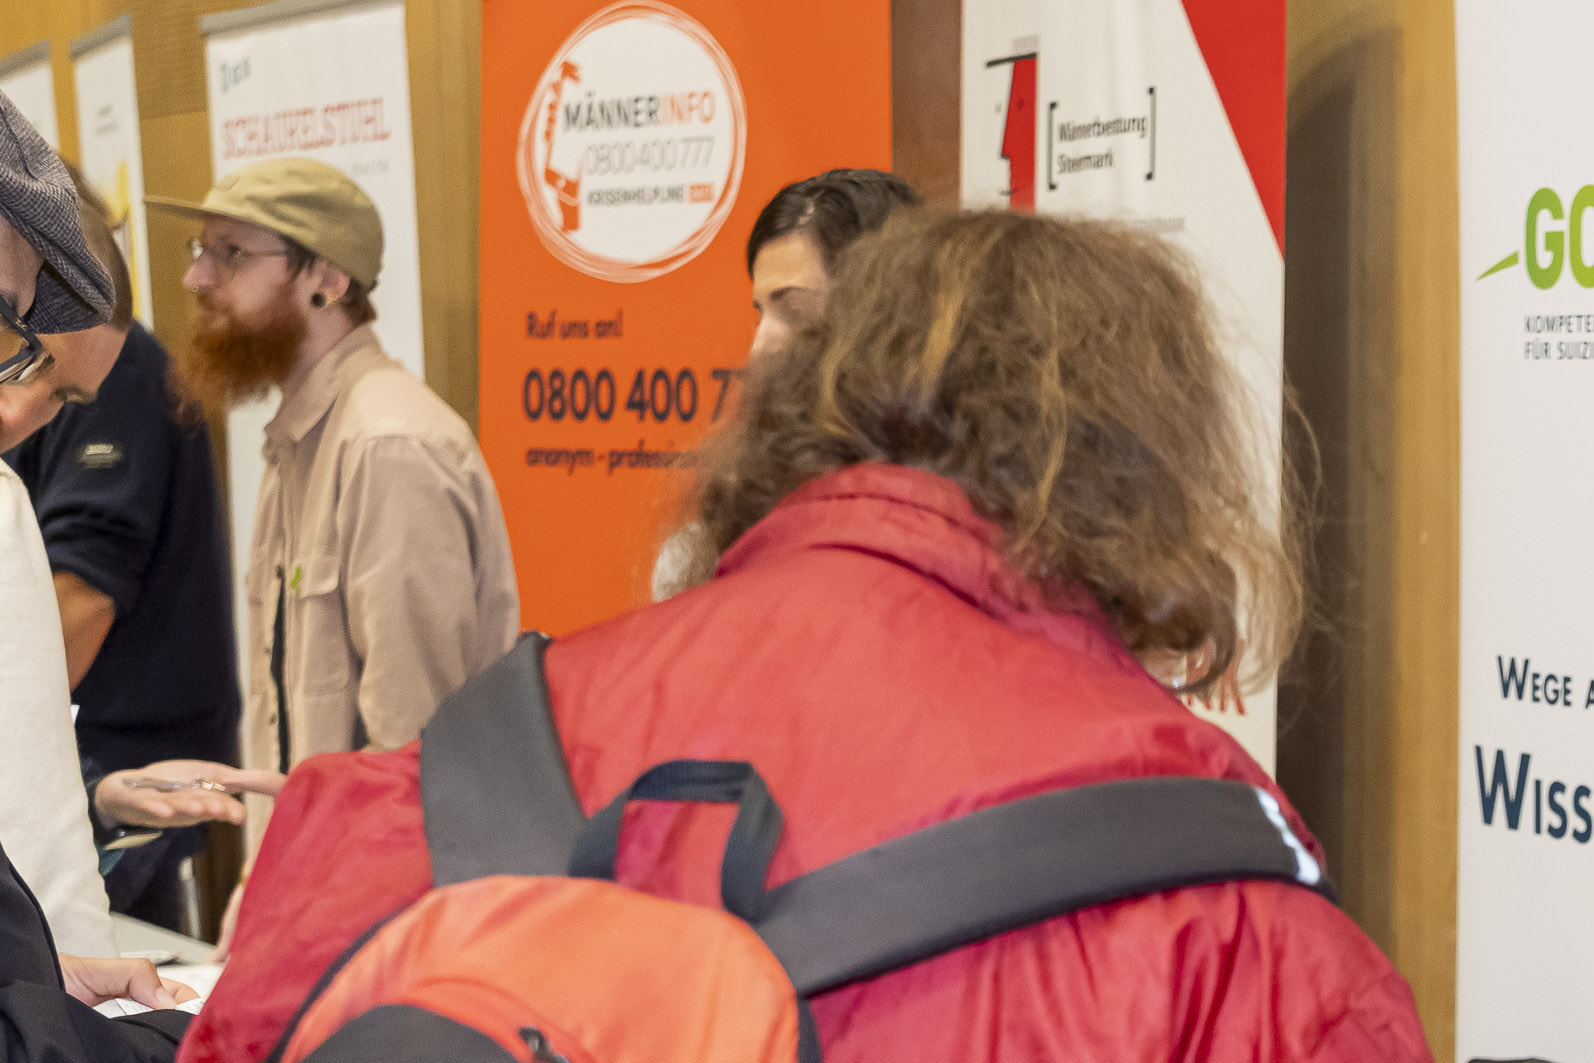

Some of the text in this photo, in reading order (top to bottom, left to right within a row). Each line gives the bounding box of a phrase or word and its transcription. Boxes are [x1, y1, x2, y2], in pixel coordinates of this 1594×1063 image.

[1524, 338, 1552, 360] FÜR
[523, 368, 615, 422] 0800
[625, 368, 698, 422] 400
[526, 449, 595, 476] anonym
